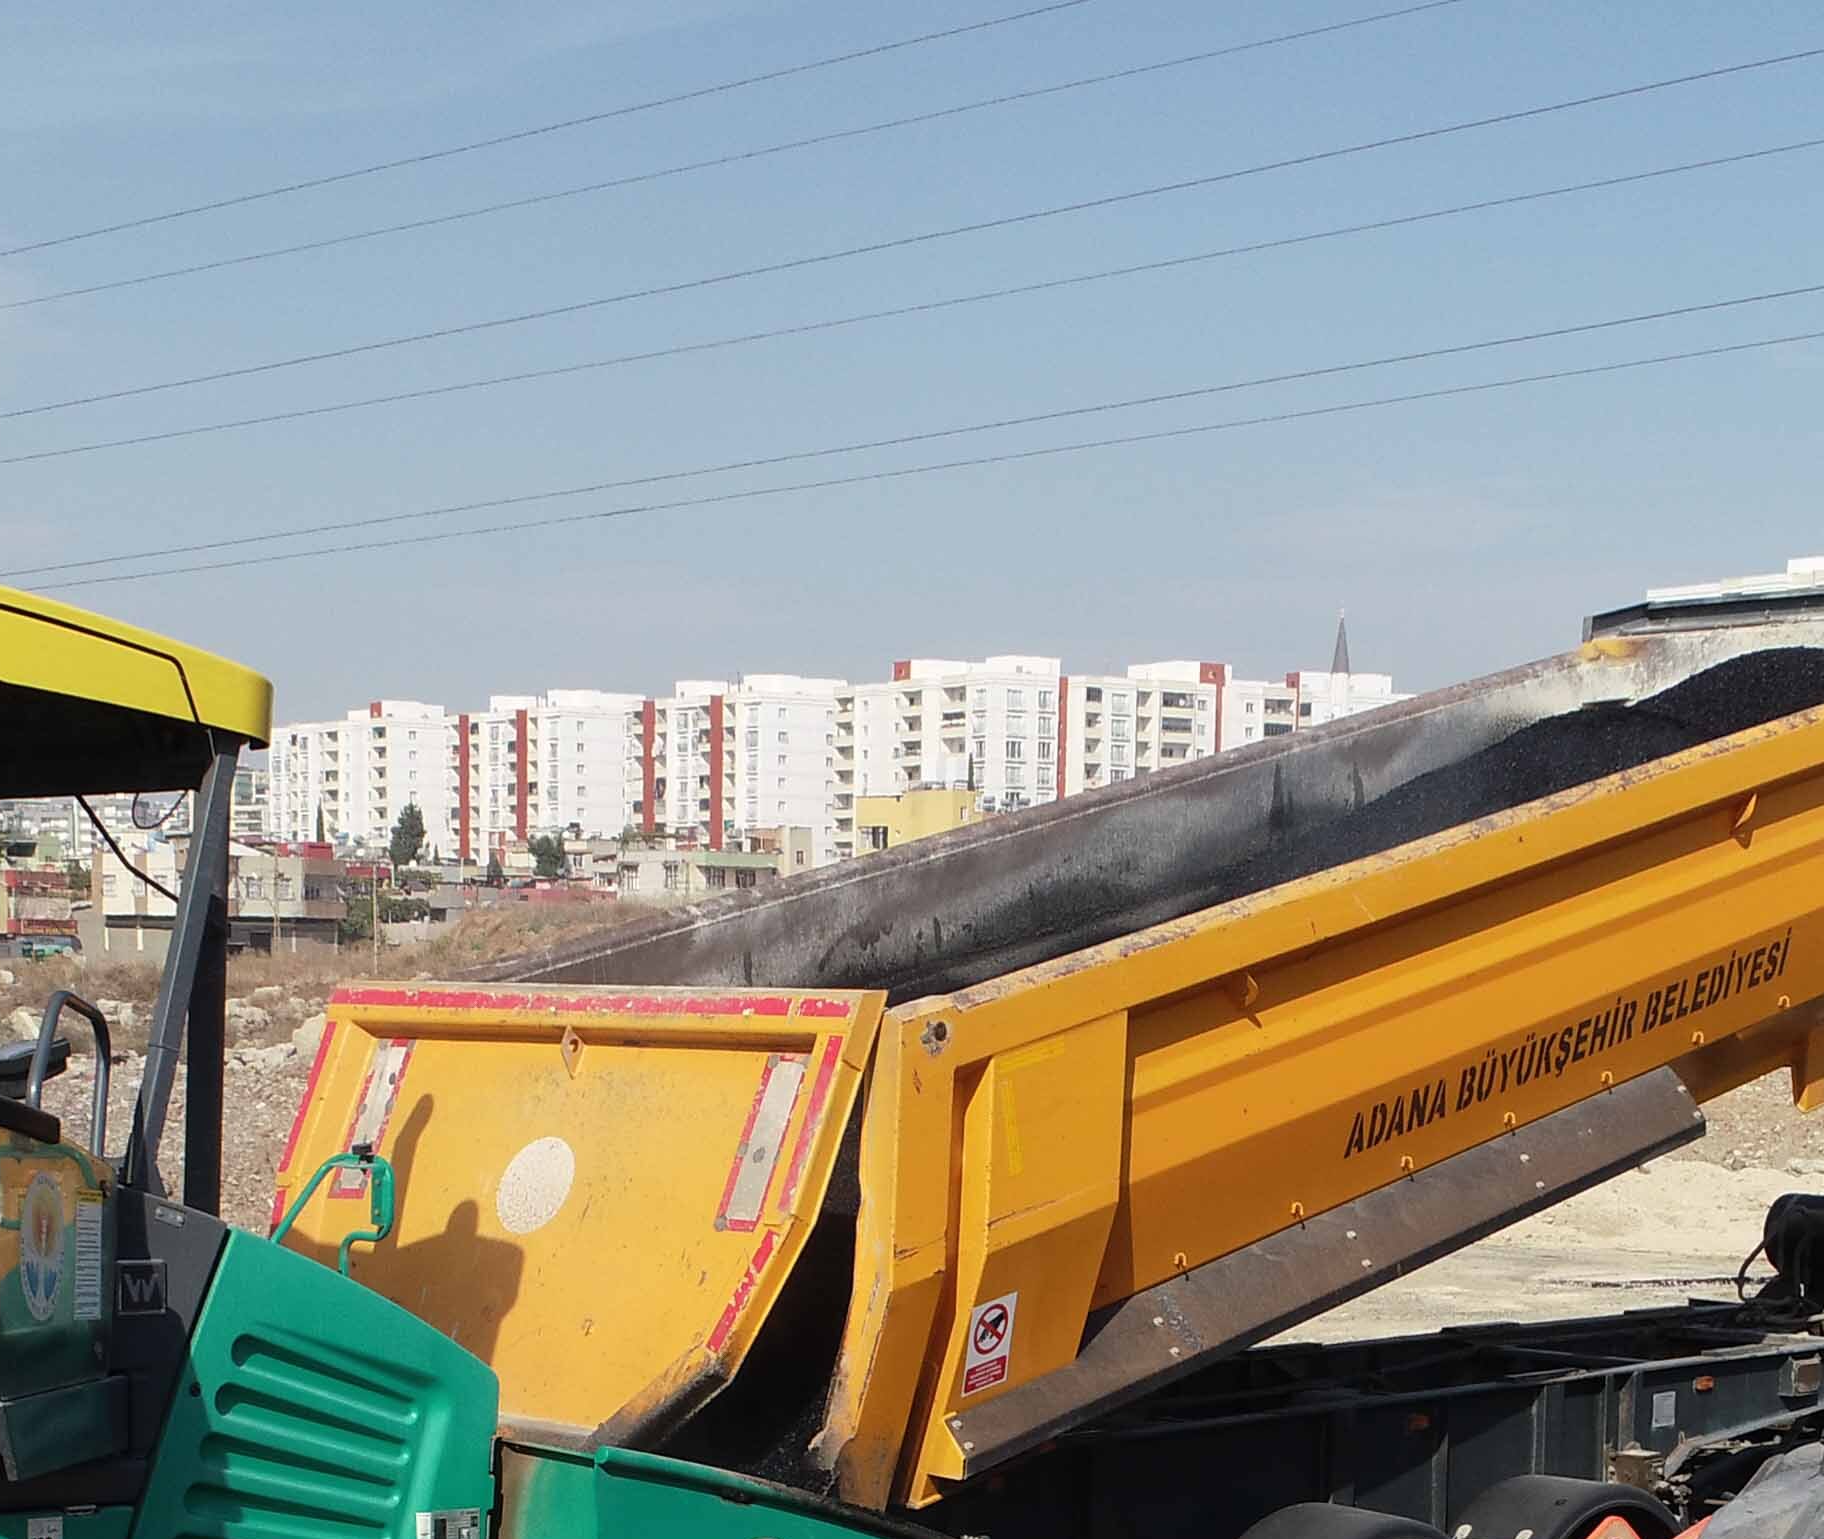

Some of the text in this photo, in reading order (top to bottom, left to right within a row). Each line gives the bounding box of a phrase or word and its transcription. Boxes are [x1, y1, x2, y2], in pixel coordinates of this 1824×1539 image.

[1344, 927, 1794, 1158] ADANA BÜYÜKŞEHİR BELEDİYESİ
